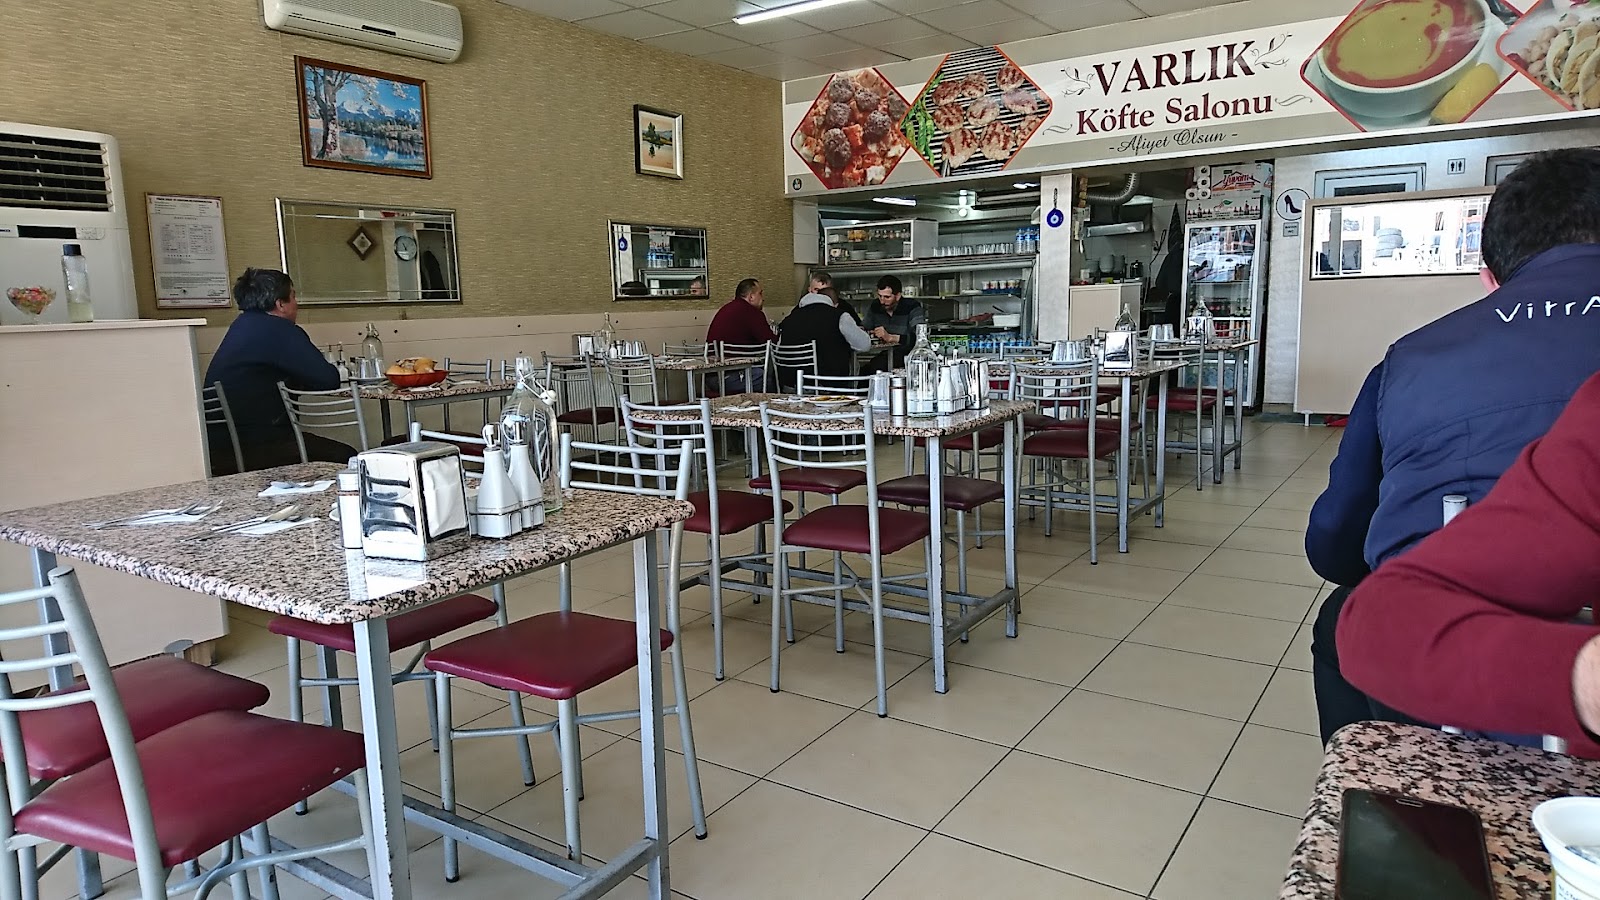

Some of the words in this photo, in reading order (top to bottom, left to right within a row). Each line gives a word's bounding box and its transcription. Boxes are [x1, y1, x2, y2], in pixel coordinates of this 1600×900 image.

[1092, 40, 1256, 96] VARLIK
[1076, 102, 1155, 135] Köfte
[1165, 92, 1274, 124] Salonu
[1173, 128, 1226, 146] Olsun
